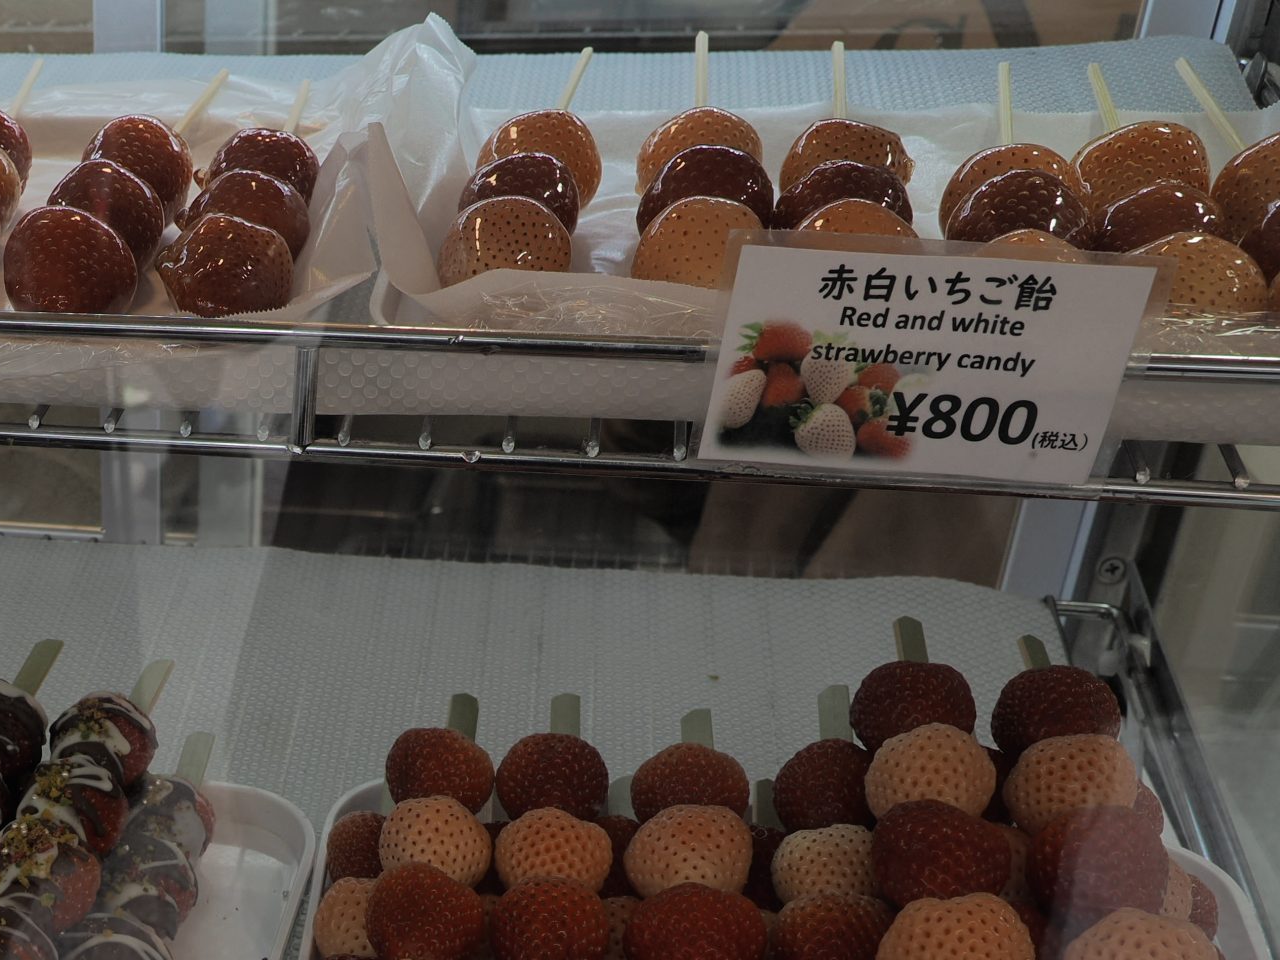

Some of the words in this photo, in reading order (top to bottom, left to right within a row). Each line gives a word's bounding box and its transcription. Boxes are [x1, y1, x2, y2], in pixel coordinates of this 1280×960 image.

[819, 264, 1058, 312] 赤白いちご飴
[839, 305, 889, 329] Red
[895, 309, 944, 331] and
[951, 313, 1026, 337] white
[811, 342, 951, 372] strawberry
[956, 351, 1036, 378] candy
[886, 391, 1039, 446] ¥800
